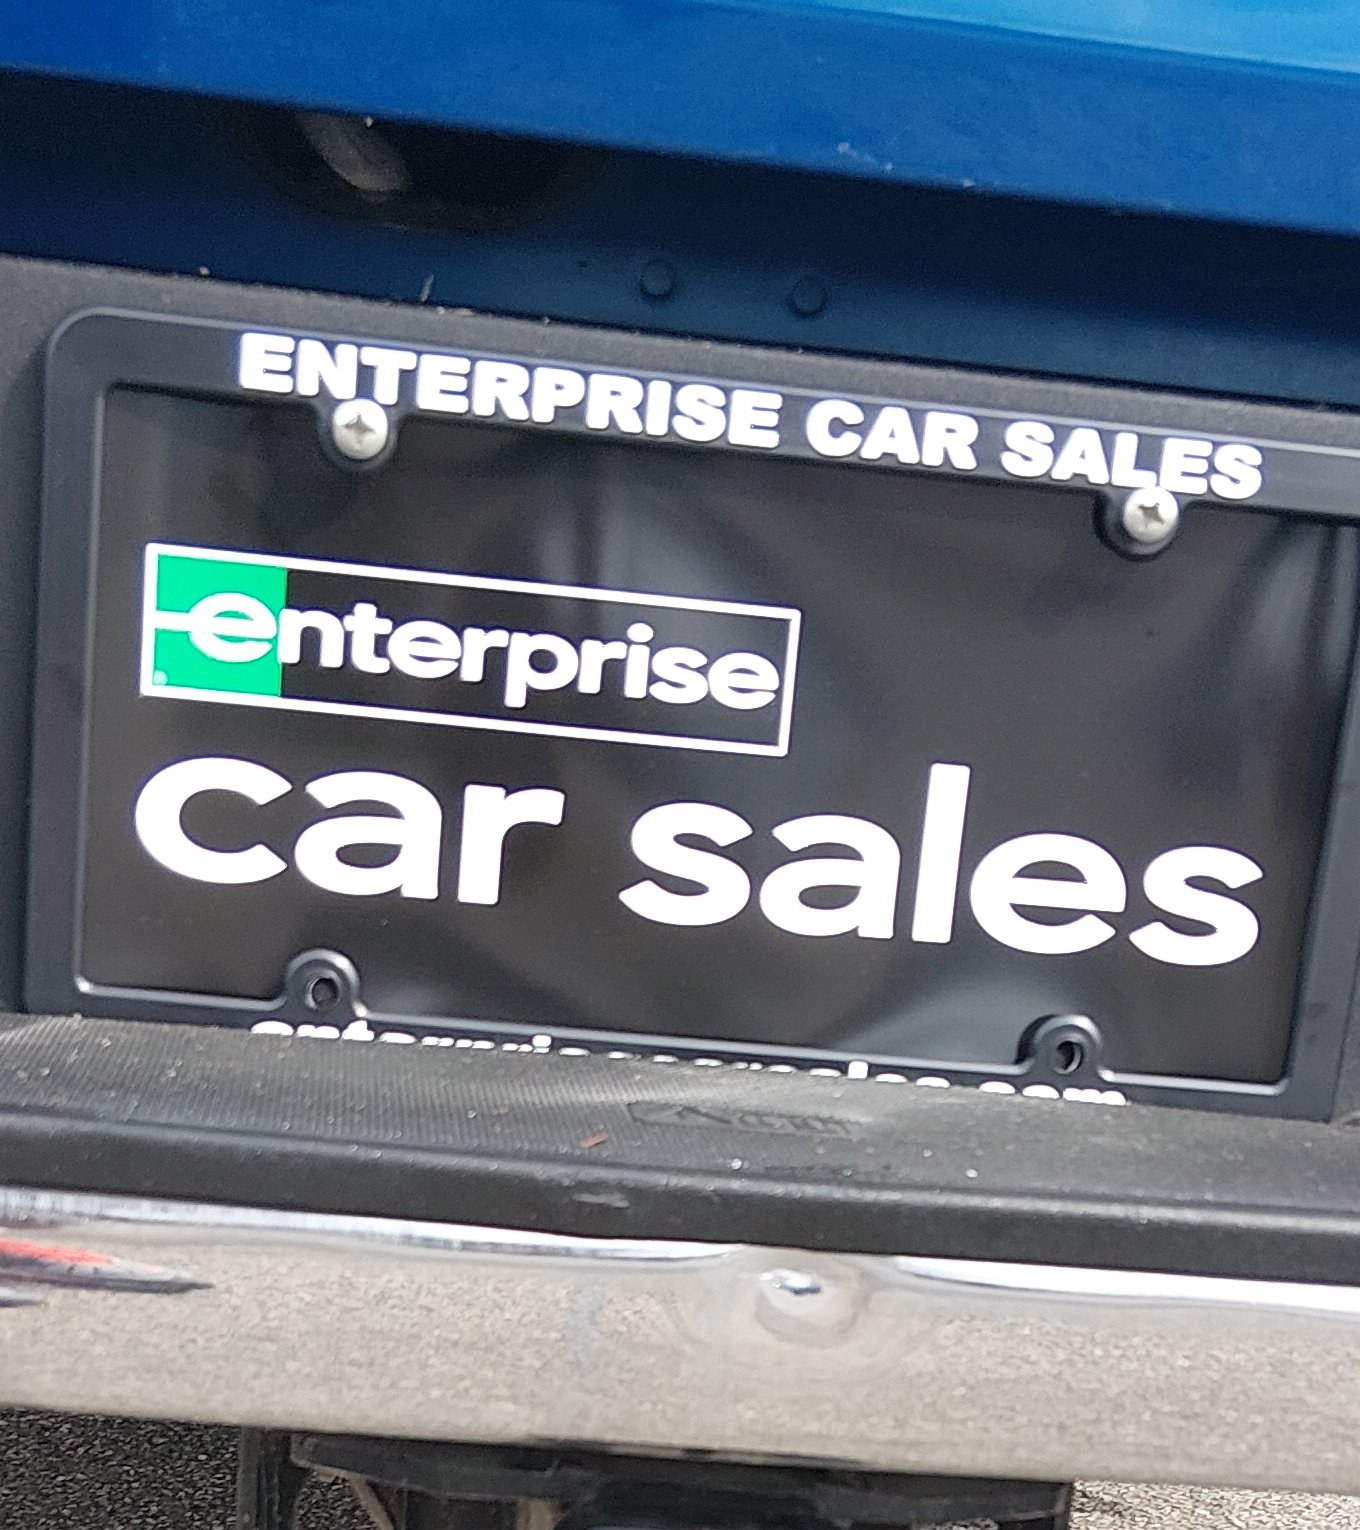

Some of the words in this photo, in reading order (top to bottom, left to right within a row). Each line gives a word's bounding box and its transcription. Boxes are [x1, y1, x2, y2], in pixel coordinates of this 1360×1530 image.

[237, 331, 784, 450] ENTERPRISE
[804, 397, 980, 471] CAR
[998, 419, 1264, 501] SALES
[170, 590, 782, 711] enterprise
[133, 756, 566, 906] car
[617, 761, 1264, 967] sales
